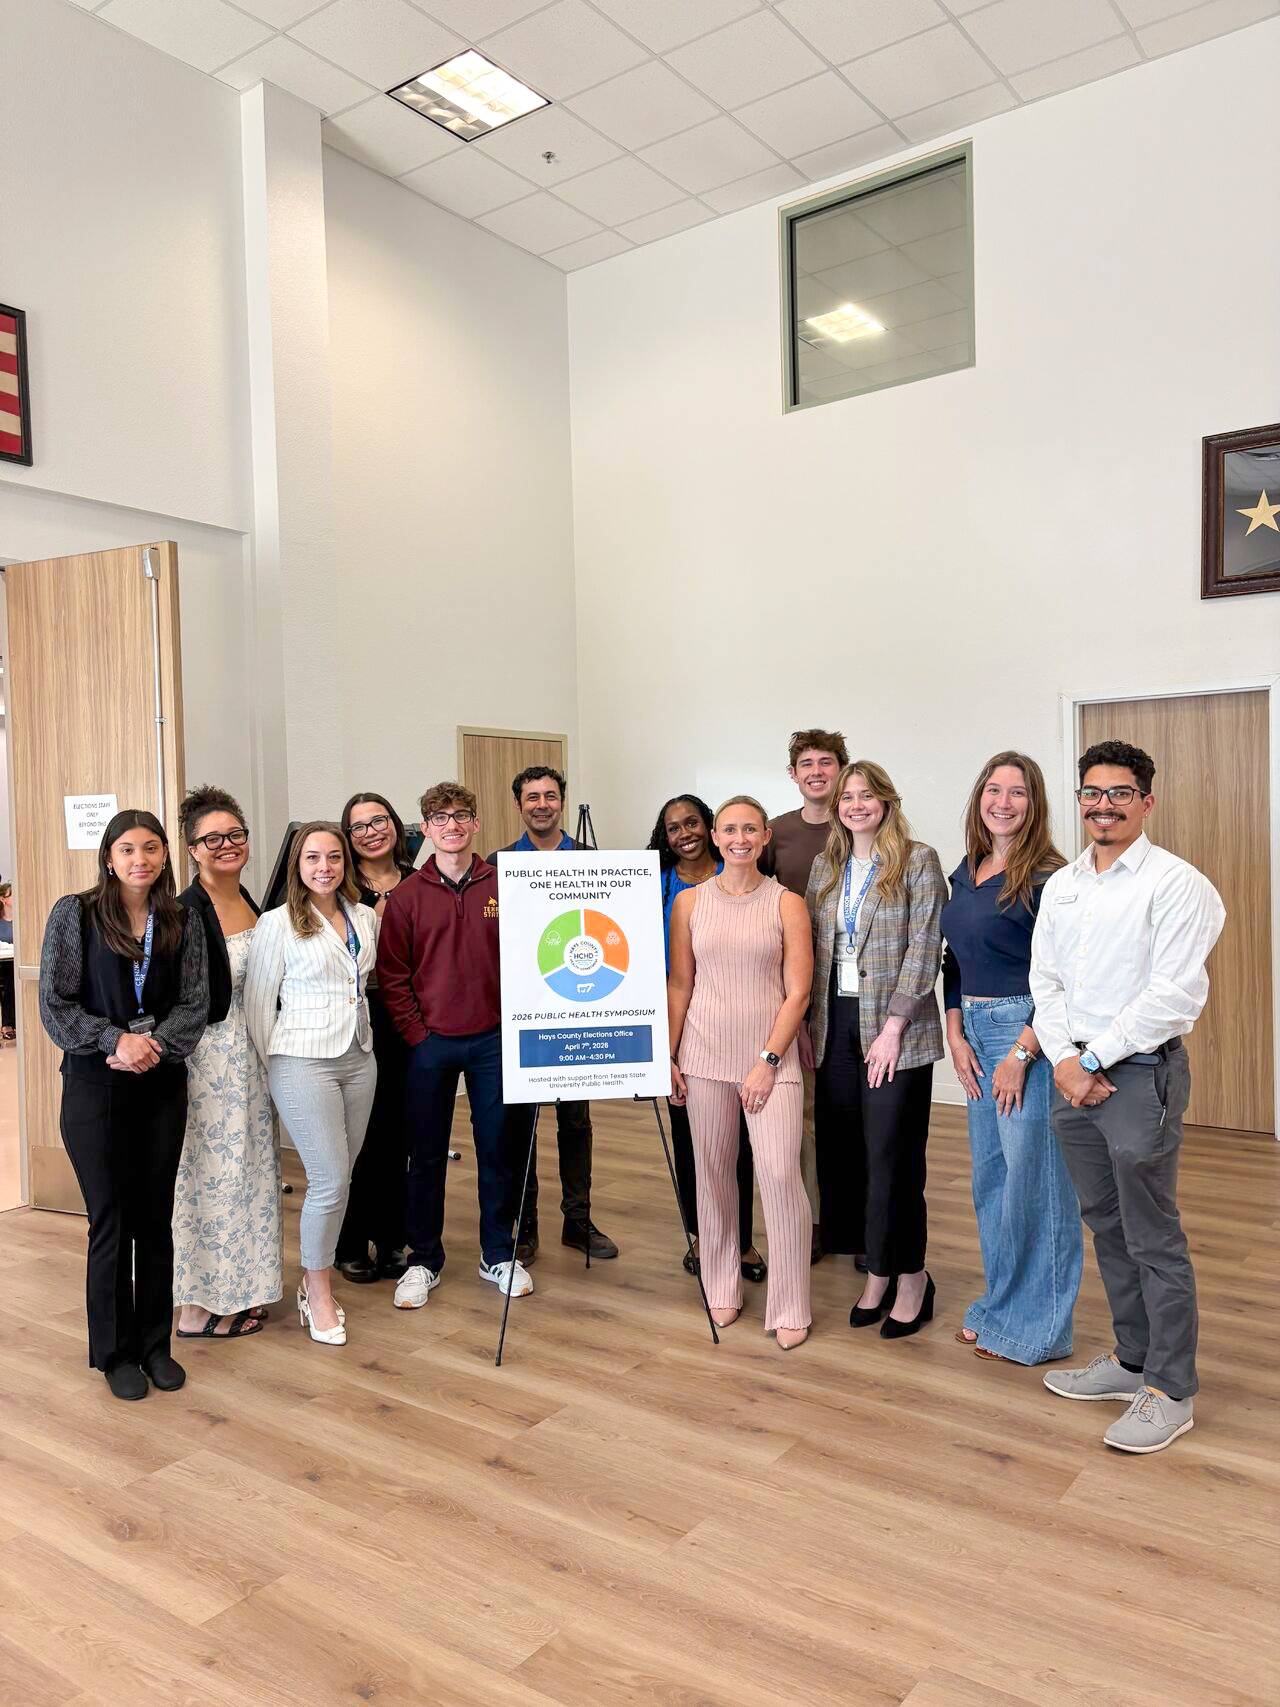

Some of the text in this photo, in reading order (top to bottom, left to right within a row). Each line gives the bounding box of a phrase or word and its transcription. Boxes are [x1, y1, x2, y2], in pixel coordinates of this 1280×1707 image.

[505, 868, 652, 878] PUBLIC HEALTH IN PRACTICE,
[529, 880, 632, 889] ONE HEALTH IN OUR
[549, 891, 612, 901] COMMUNITY
[573, 952, 594, 960] HCHD
[511, 1009, 656, 1021] 2026 PUBLIC HEALTH SYMPOSIUM
[538, 1030, 634, 1042] Hays County Elections Office
[564, 1043, 580, 1051] April
[567, 1074, 592, 1083] support
[593, 1073, 609, 1081] from
[610, 1072, 628, 1080] Texas
[629, 1071, 646, 1079] State
[549, 1081, 581, 1090] University
[602, 1079, 624, 1087] Health.
